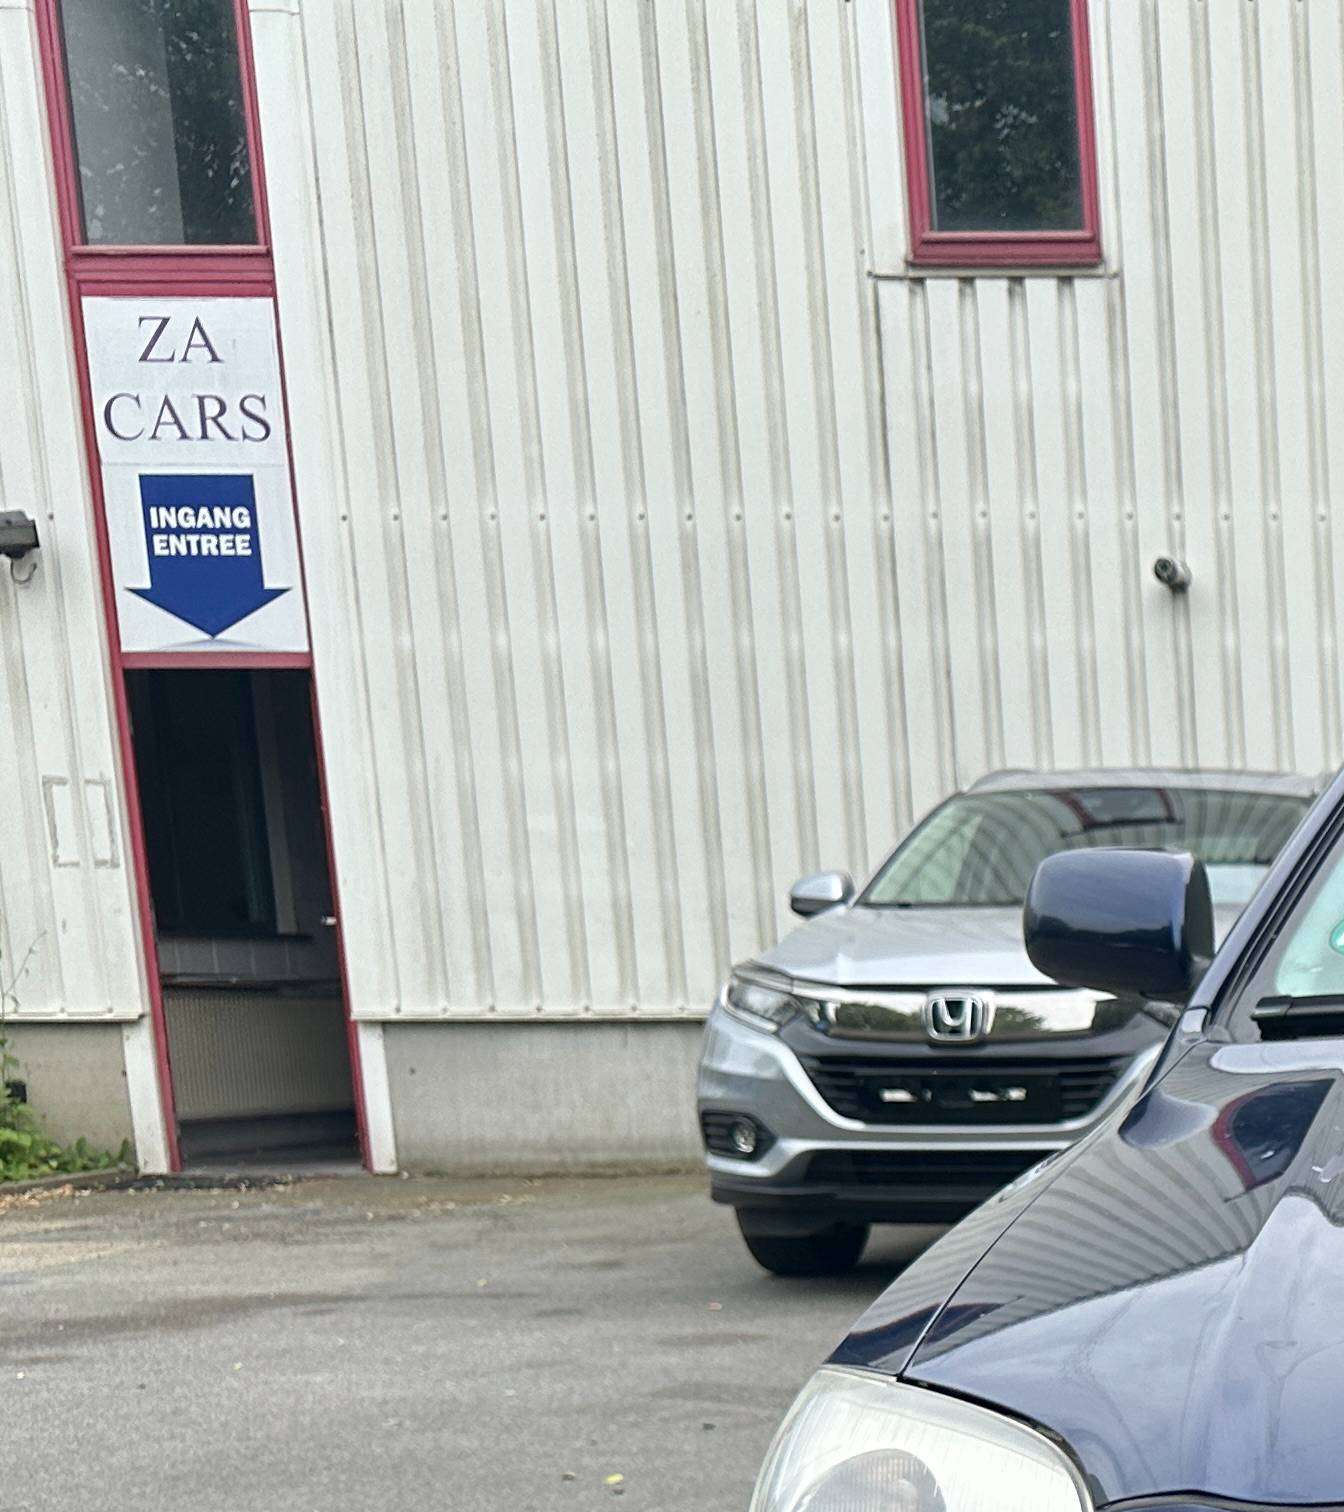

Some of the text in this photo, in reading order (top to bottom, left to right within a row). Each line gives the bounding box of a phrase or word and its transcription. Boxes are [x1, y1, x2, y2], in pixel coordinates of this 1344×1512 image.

[138, 315, 223, 363] ZA
[104, 392, 272, 443] CARS
[150, 506, 251, 529] INGANG
[152, 533, 252, 556] ENTREE
